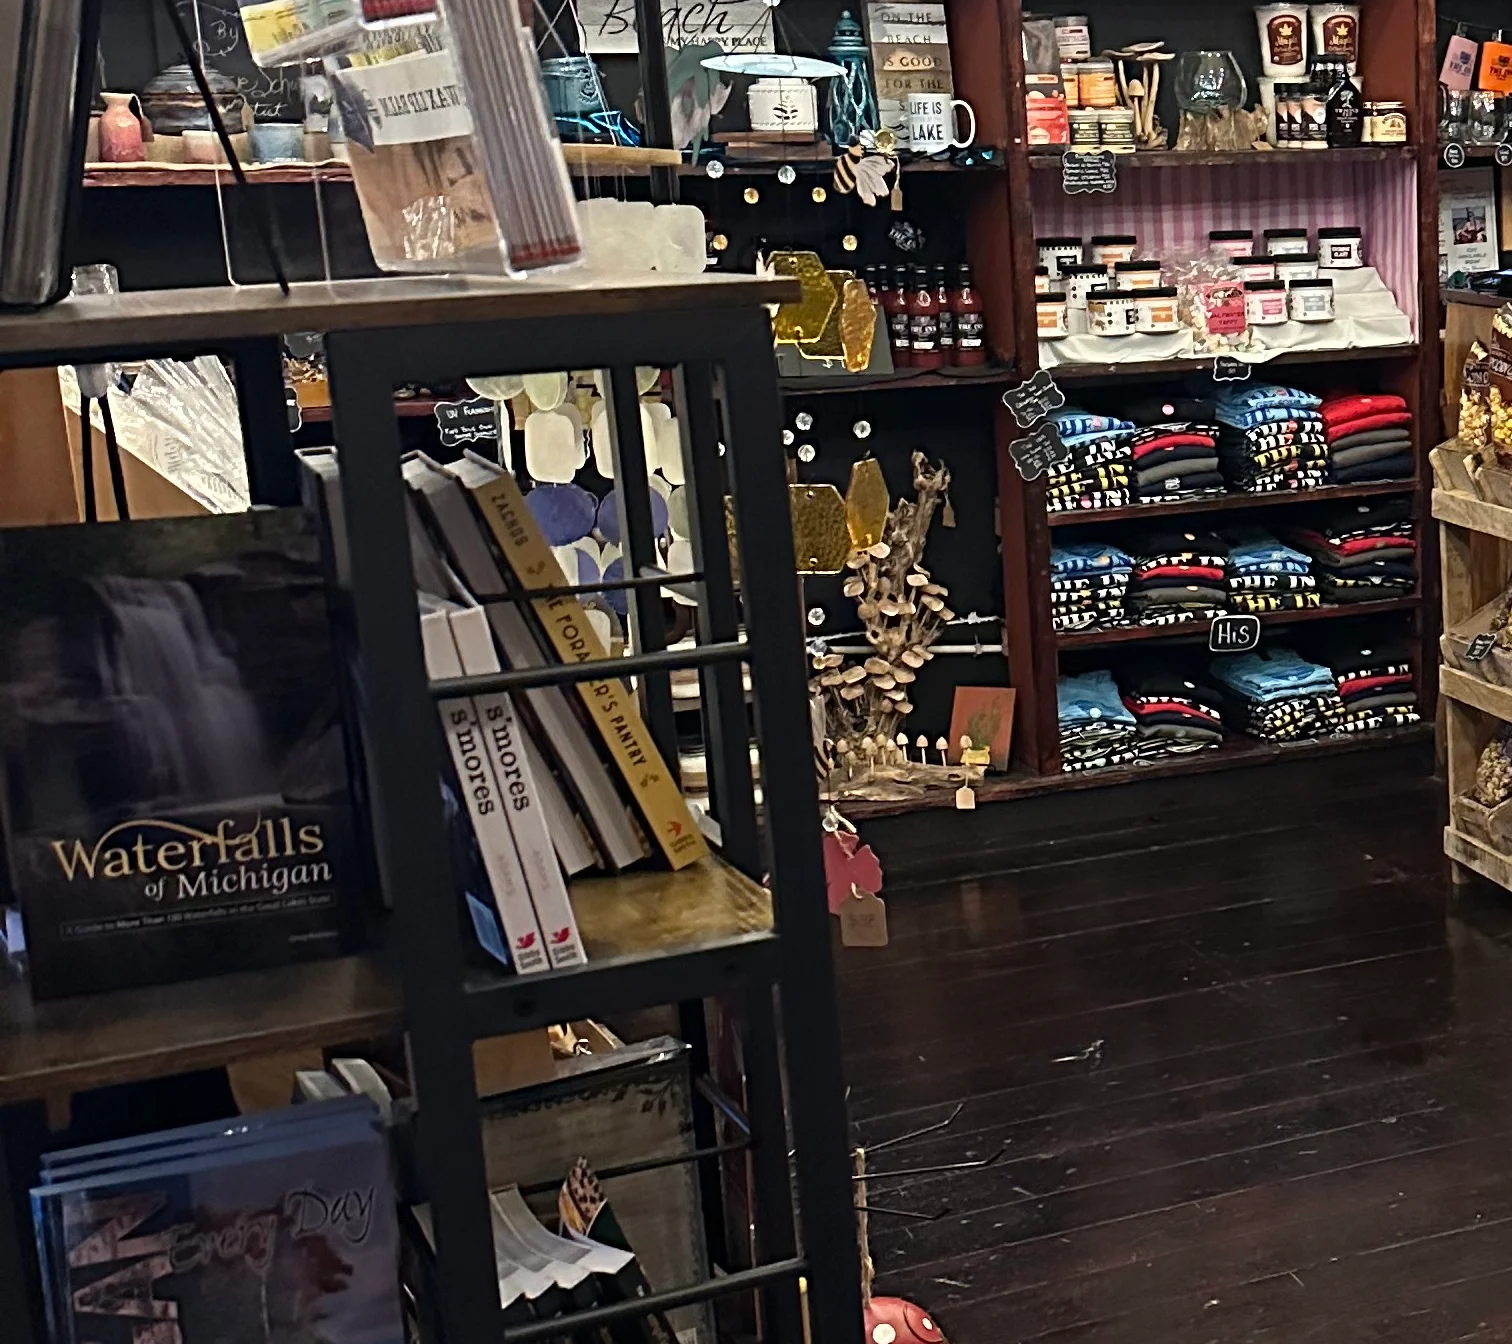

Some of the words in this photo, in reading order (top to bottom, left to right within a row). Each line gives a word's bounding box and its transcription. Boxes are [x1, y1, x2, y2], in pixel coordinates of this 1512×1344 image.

[881, 12, 900, 22] ON
[908, 12, 932, 22] THE
[731, 37, 767, 47] PLACE
[887, 34, 931, 44] BEACH
[900, 57, 942, 67] GOOD
[886, 79, 911, 89] FOR
[919, 79, 944, 89] THE
[910, 102, 928, 114] LIFE
[932, 102, 942, 114] IS
[912, 124, 943, 140] LAKE
[491, 493, 528, 547] ZACHOS
[610, 709, 648, 767] PANTRY
[450, 708, 495, 816] s'mores
[488, 705, 530, 812] s'mores
[52, 809, 325, 883] Waterfalls
[144, 875, 168, 902] of
[177, 862, 333, 901] Michigan
[165, 1213, 278, 1274] Every
[285, 1176, 379, 1247] Day
